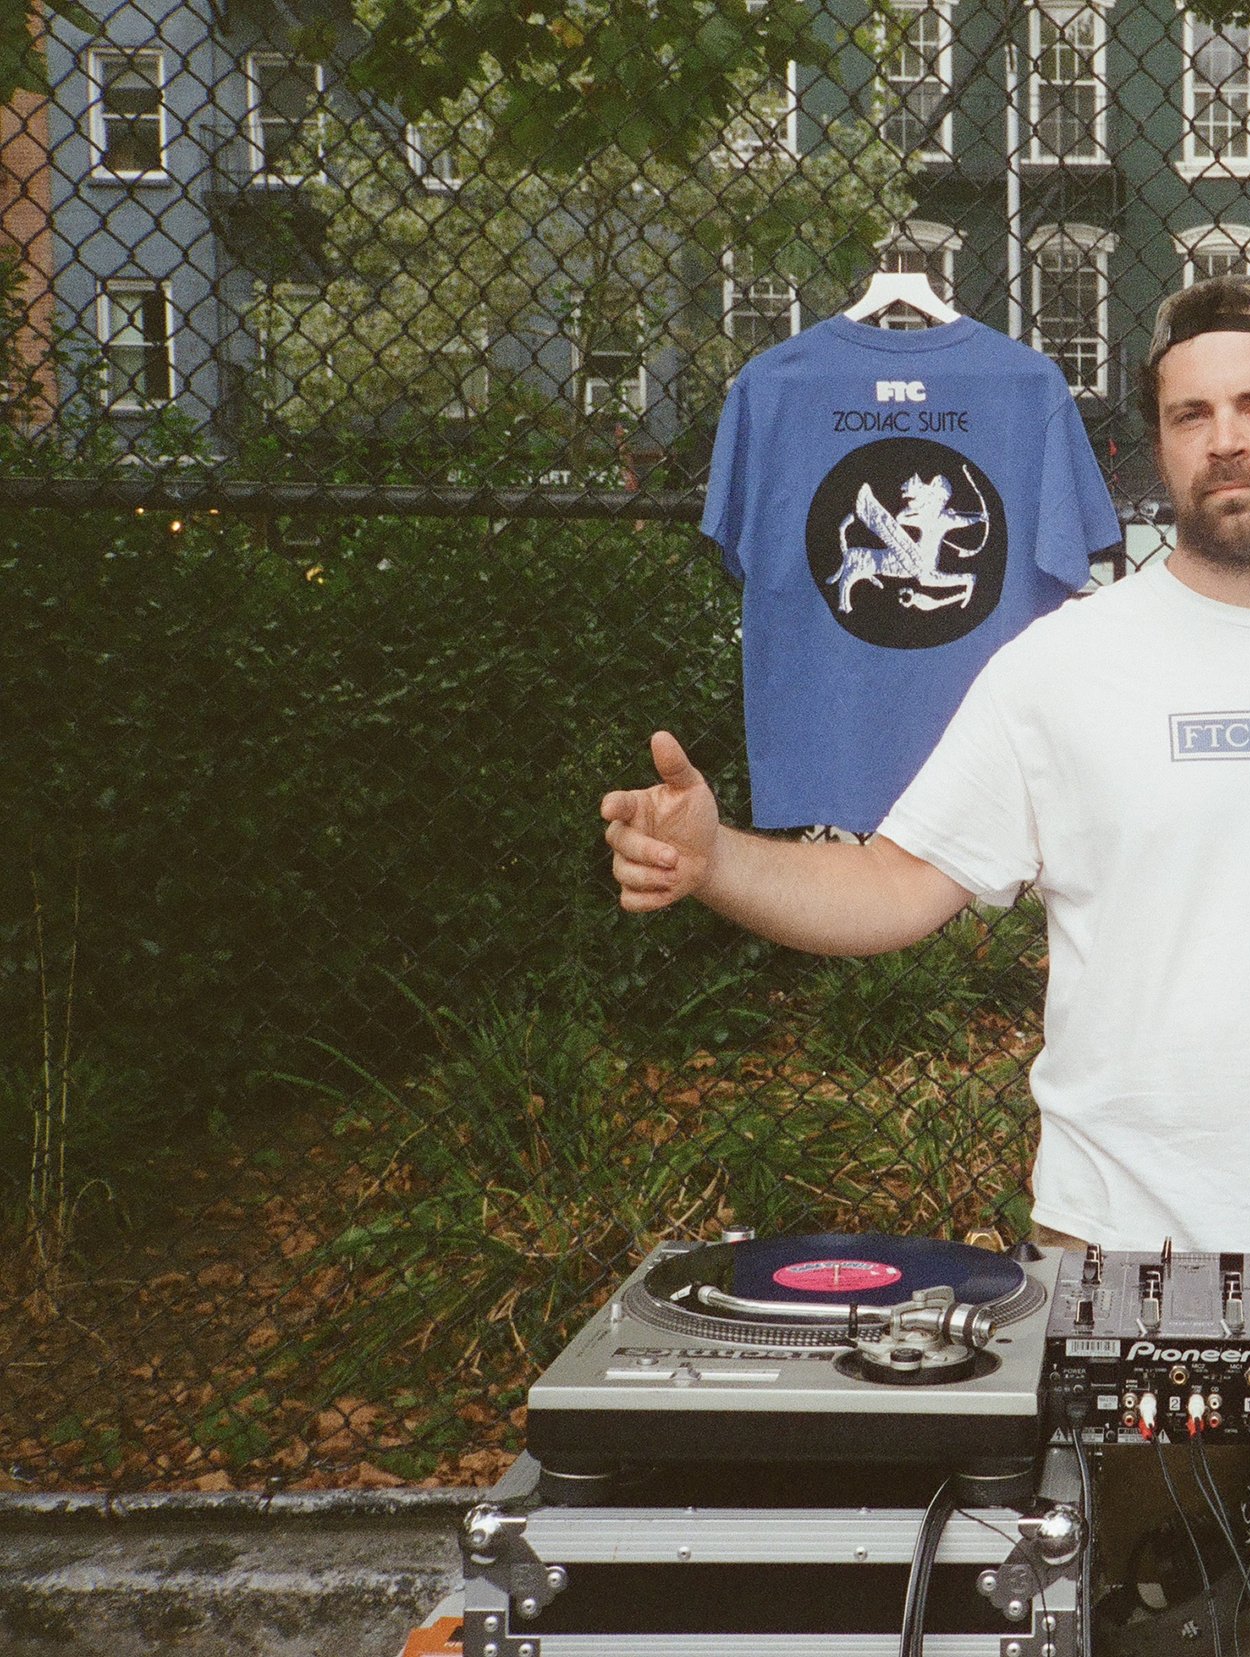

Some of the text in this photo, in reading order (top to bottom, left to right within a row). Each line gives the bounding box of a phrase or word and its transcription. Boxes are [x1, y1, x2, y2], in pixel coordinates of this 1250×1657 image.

[876, 381, 926, 402] FTC
[832, 411, 969, 433] ZODIAC SUITE
[1183, 722, 1250, 749] FTC
[1171, 1398, 1179, 1409] 2
